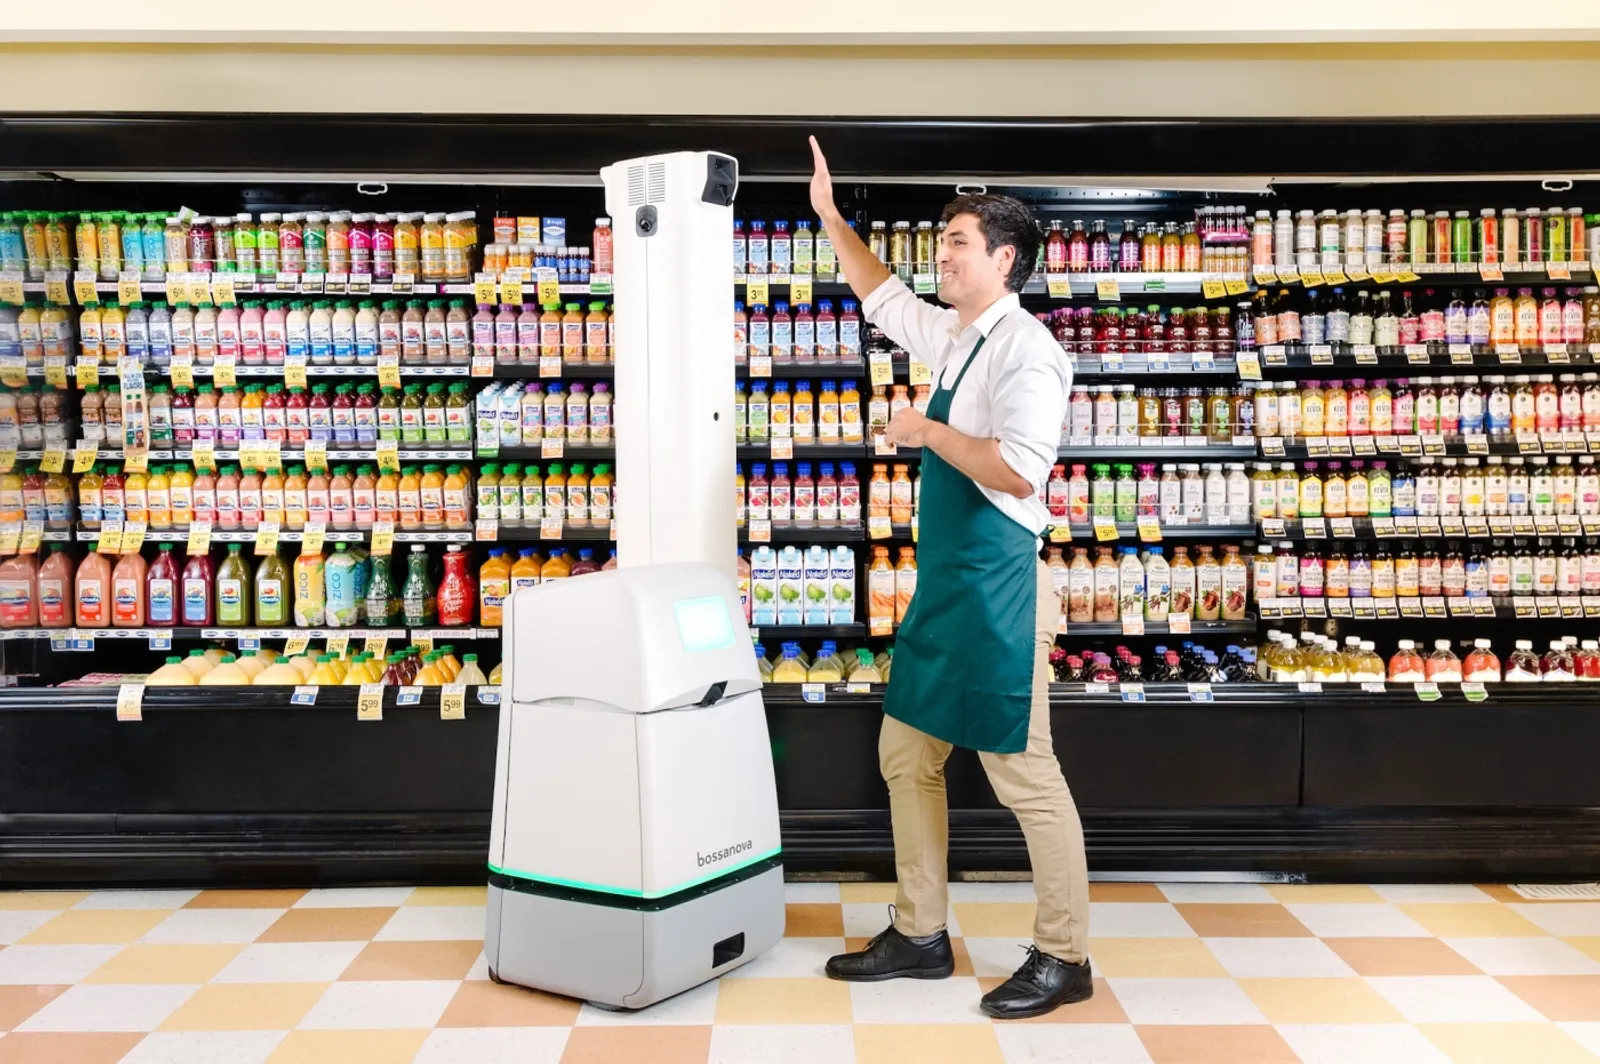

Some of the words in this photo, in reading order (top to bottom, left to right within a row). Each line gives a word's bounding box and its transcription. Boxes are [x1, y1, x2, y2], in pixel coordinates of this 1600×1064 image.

[76, 236, 85, 258] ZICO
[102, 236, 111, 258] ZICO
[124, 237, 132, 258] ZICO
[148, 237, 156, 259] ZICO
[172, 237, 181, 258] ZICO
[754, 570, 775, 579] Naked
[780, 570, 800, 579] Naked
[806, 570, 828, 579] Naked
[832, 570, 854, 579] Naked
[299, 572, 309, 599] ZICO
[331, 572, 342, 599] ZICO
[696, 839, 753, 867] bossanova
